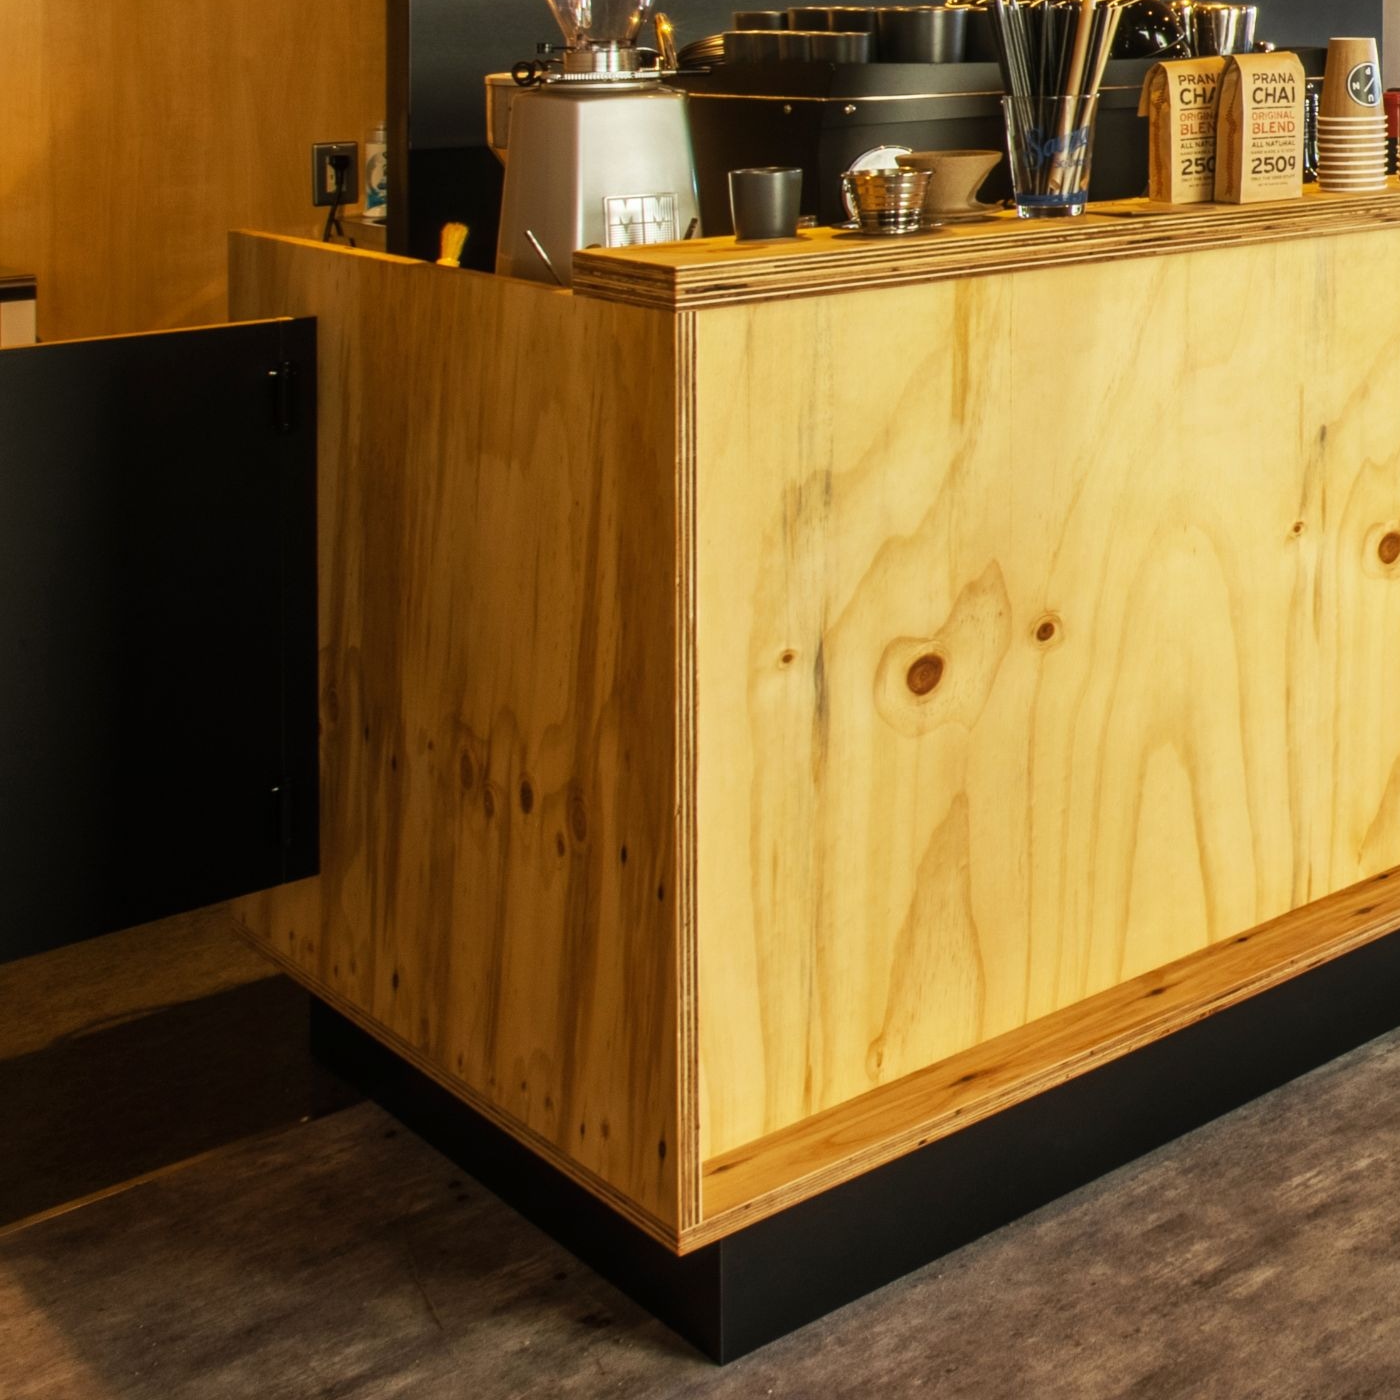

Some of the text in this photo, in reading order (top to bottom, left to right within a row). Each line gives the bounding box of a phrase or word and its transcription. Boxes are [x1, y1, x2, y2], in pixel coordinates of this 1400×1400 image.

[1252, 72, 1296, 85] PRANA
[1252, 86, 1296, 104] CHAI
[1251, 110, 1295, 121] ORIGINAL
[1252, 121, 1296, 135] BLEND
[1251, 155, 1296, 175] 250g
